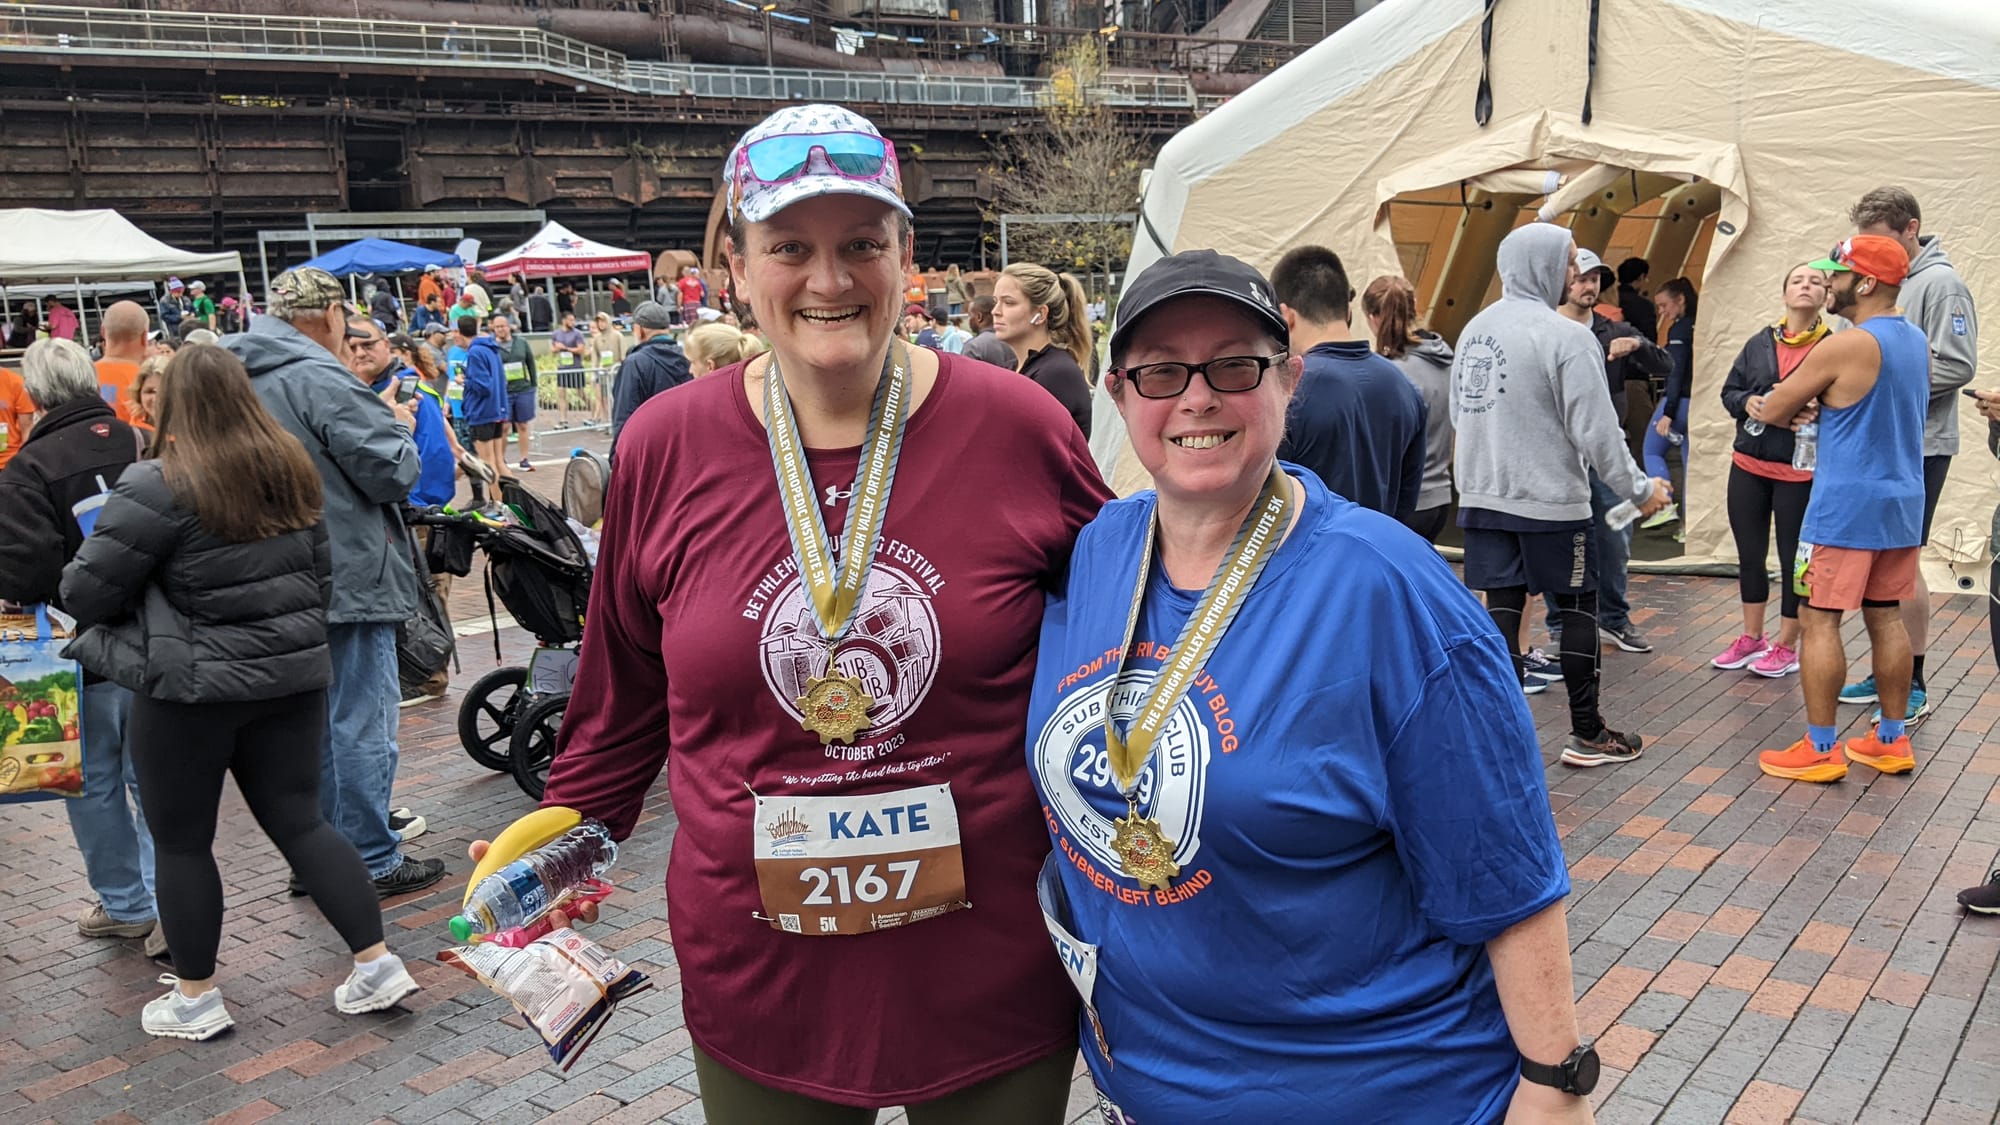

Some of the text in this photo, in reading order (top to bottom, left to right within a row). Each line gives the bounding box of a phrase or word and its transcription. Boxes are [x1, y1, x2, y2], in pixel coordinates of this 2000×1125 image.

[1460, 334, 1507, 366] OYAL BLISS
[769, 361, 827, 588] THE LEHIGH VALLEY ORTHOPEDIC INSTITUTE 5K
[844, 364, 904, 591] THE LEHIGH VALLEY ORTHOPEDIC INSTITUTE 5K
[742, 553, 798, 621] BETHLEH
[886, 538, 946, 596] FESTIVAL
[1141, 709, 1161, 733] THE
[1154, 670, 1184, 711] LEHIGH
[1176, 631, 1206, 671] VALLEY
[1199, 565, 1245, 634] ORTHOPEDIC
[1237, 511, 1276, 568] INSTITUTE
[1267, 495, 1285, 514] 5K
[1057, 656, 1103, 694] FROM
[1104, 644, 1133, 664] TH
[1062, 701, 1101, 734] SUB
[1111, 689, 1145, 708] THI
[1194, 669, 1239, 753] UY BLOG
[824, 733, 906, 761] OCTOBER 2023
[1165, 718, 1186, 776] CLUB
[811, 773, 843, 786] getting
[845, 771, 861, 781] the
[861, 766, 886, 779] band
[829, 803, 930, 840] KATE
[1042, 805, 1212, 907] NO SUBBER LEFT BEHIND
[800, 860, 921, 905] 2167
[819, 916, 838, 932] 5K
